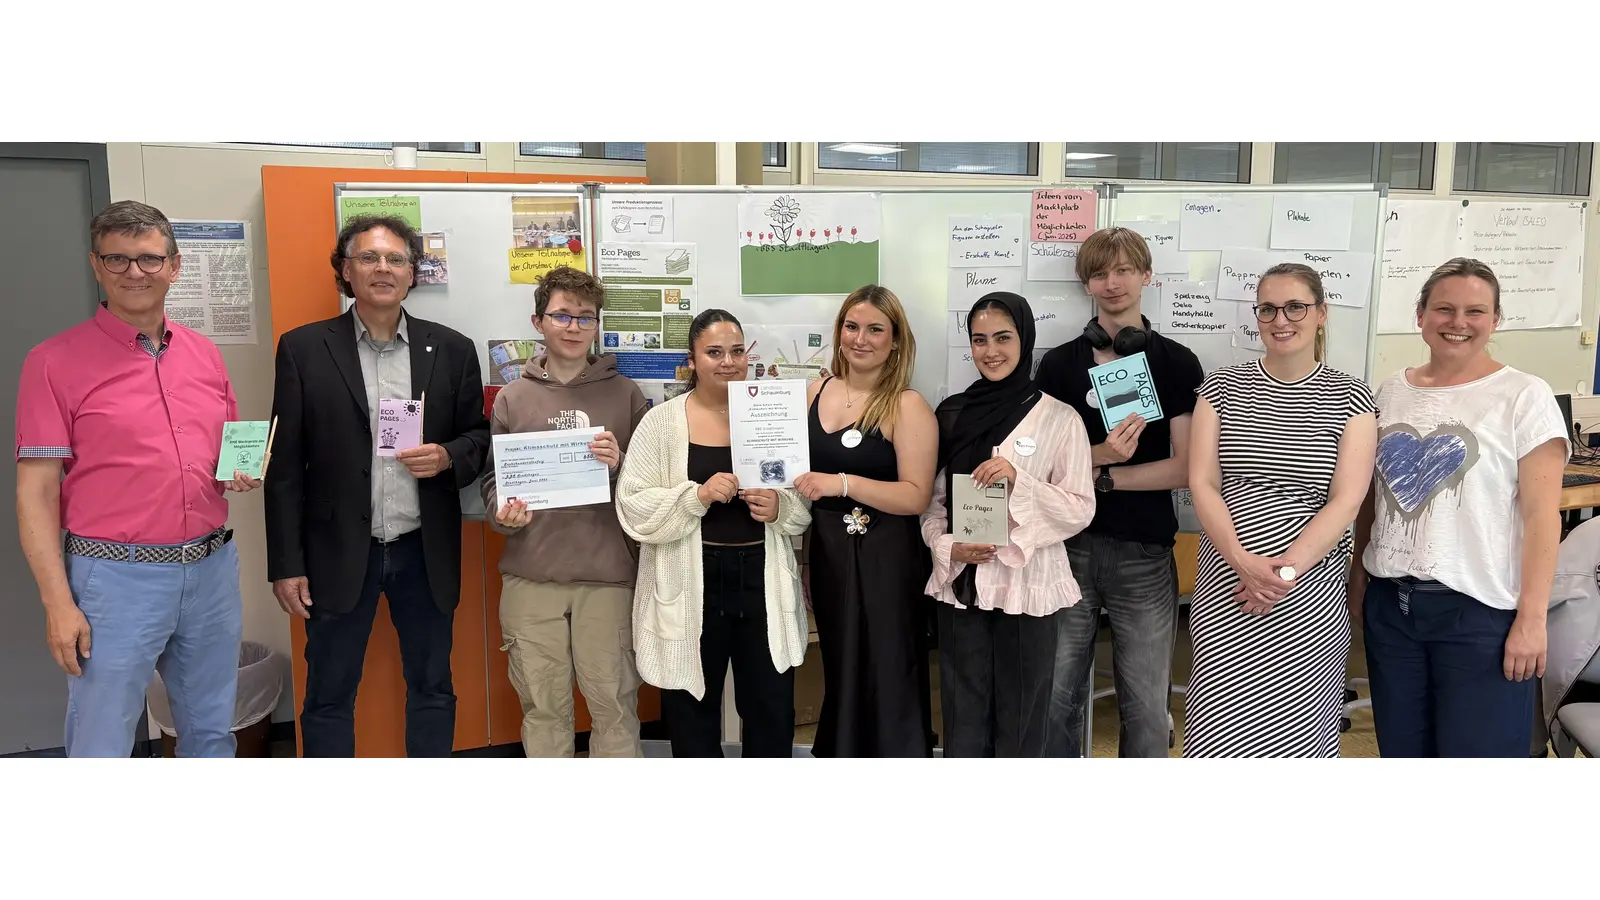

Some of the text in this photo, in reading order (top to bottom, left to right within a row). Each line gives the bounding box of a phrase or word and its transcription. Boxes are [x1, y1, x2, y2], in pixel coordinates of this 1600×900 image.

[1036, 191, 1061, 200] Ideen
[1287, 209, 1312, 222] Plakate
[1036, 221, 1088, 235] Möglichkeiten
[1057, 232, 1077, 240] 2025)
[601, 248, 641, 258] Eco Pages
[1304, 253, 1332, 263] Papier
[510, 263, 520, 271] der
[966, 272, 998, 288] Blume
[1173, 292, 1211, 304] Spielzeug
[1034, 312, 1056, 322] asteln
[1171, 320, 1227, 331] Geschenkpapier
[1098, 369, 1128, 387] ECO
[1133, 371, 1156, 408] PAGES
[523, 443, 559, 451] Klimaschutz
[974, 504, 993, 512] Pages
[1408, 559, 1438, 576] heart
